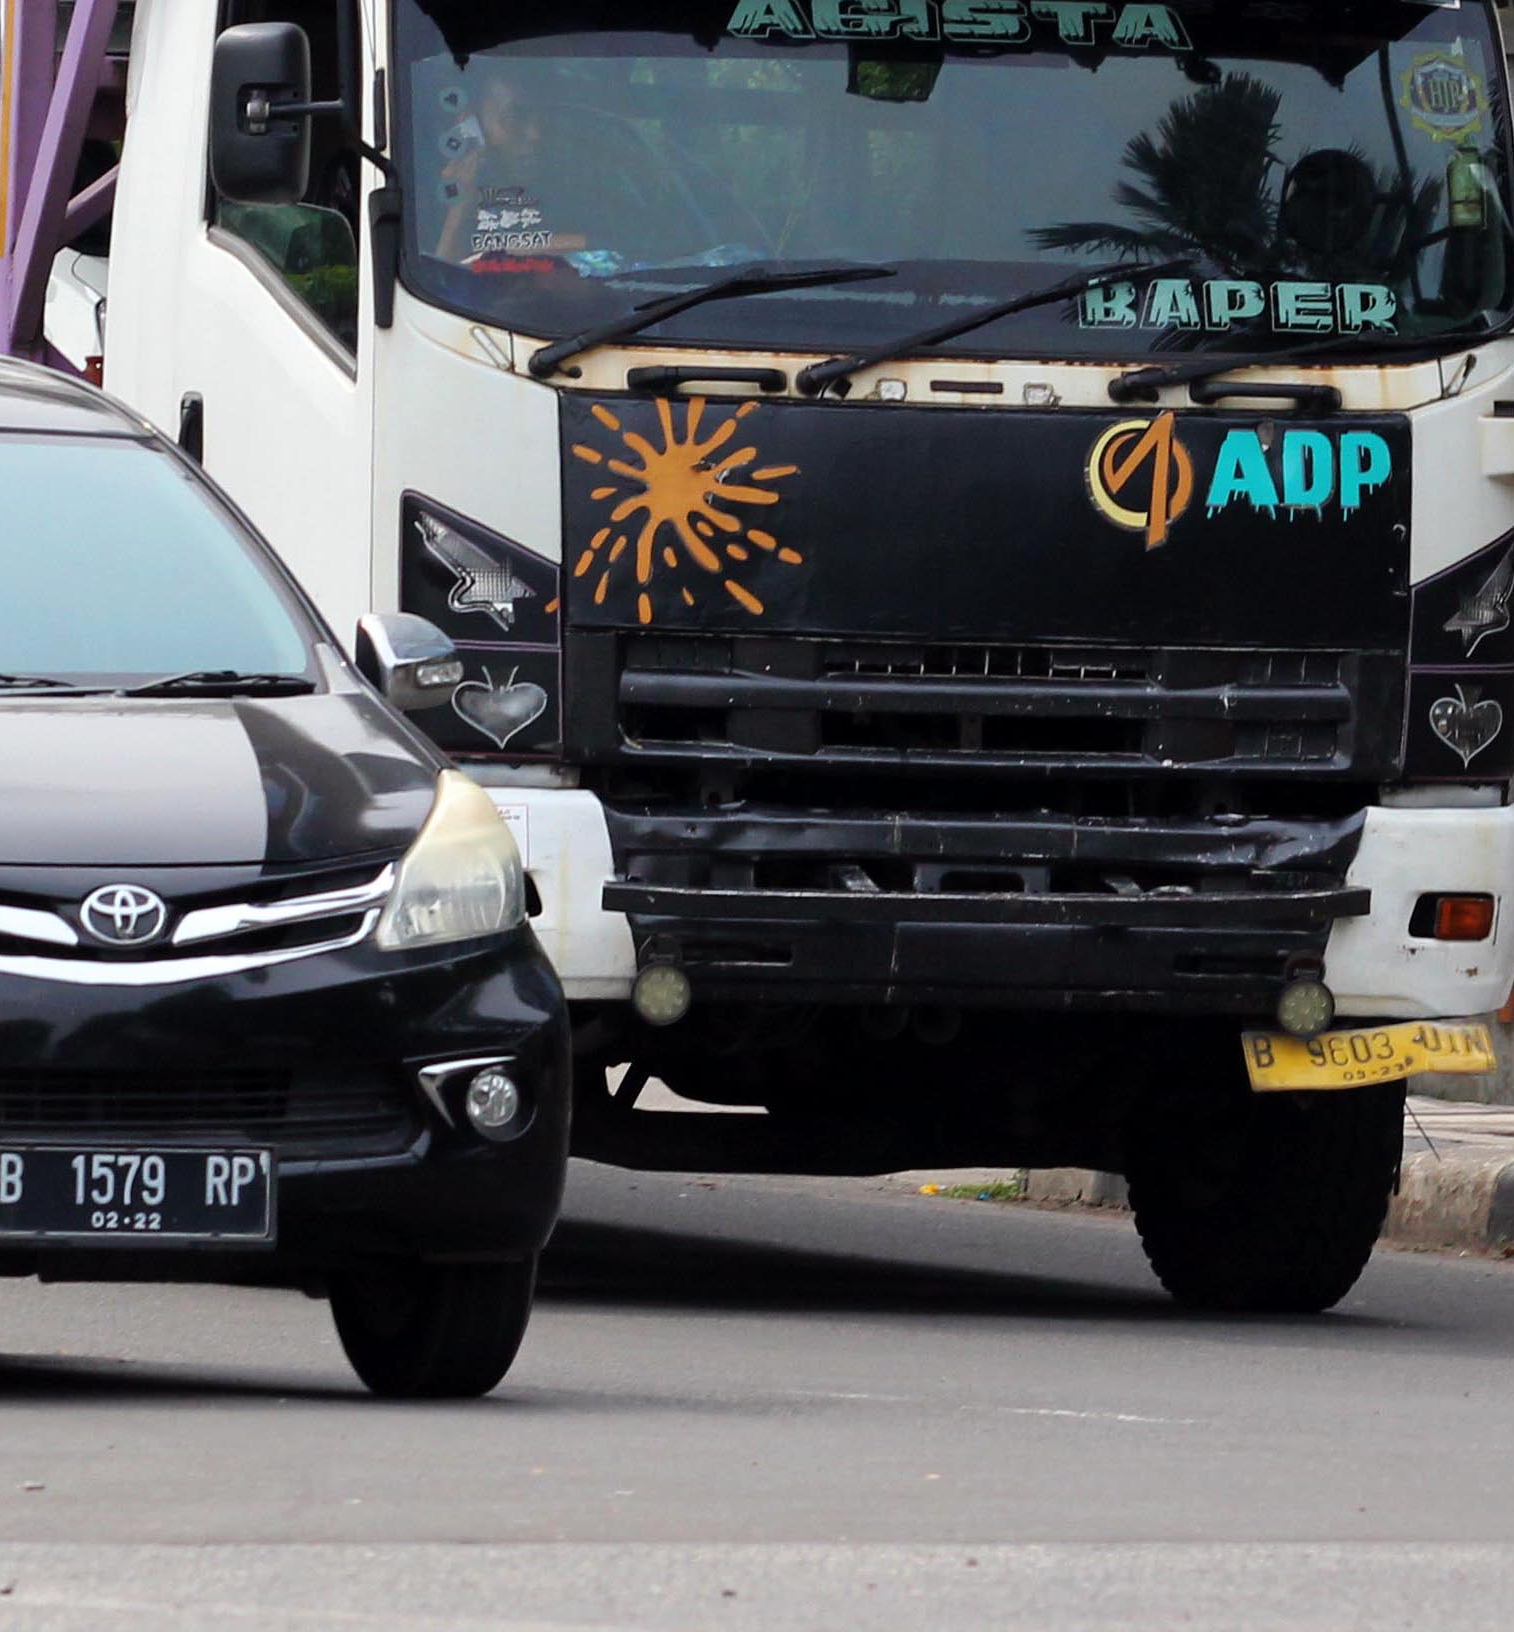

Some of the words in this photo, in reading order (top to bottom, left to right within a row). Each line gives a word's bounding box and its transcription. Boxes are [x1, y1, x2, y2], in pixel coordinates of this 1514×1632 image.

[471, 230, 552, 251] BANGSAT
[1078, 278, 1399, 336] BAPER
[1205, 428, 1392, 520] ADP
[1252, 1034, 1275, 1069] B
[71, 1153, 167, 1206] 1579
[204, 1155, 257, 1207] RP
